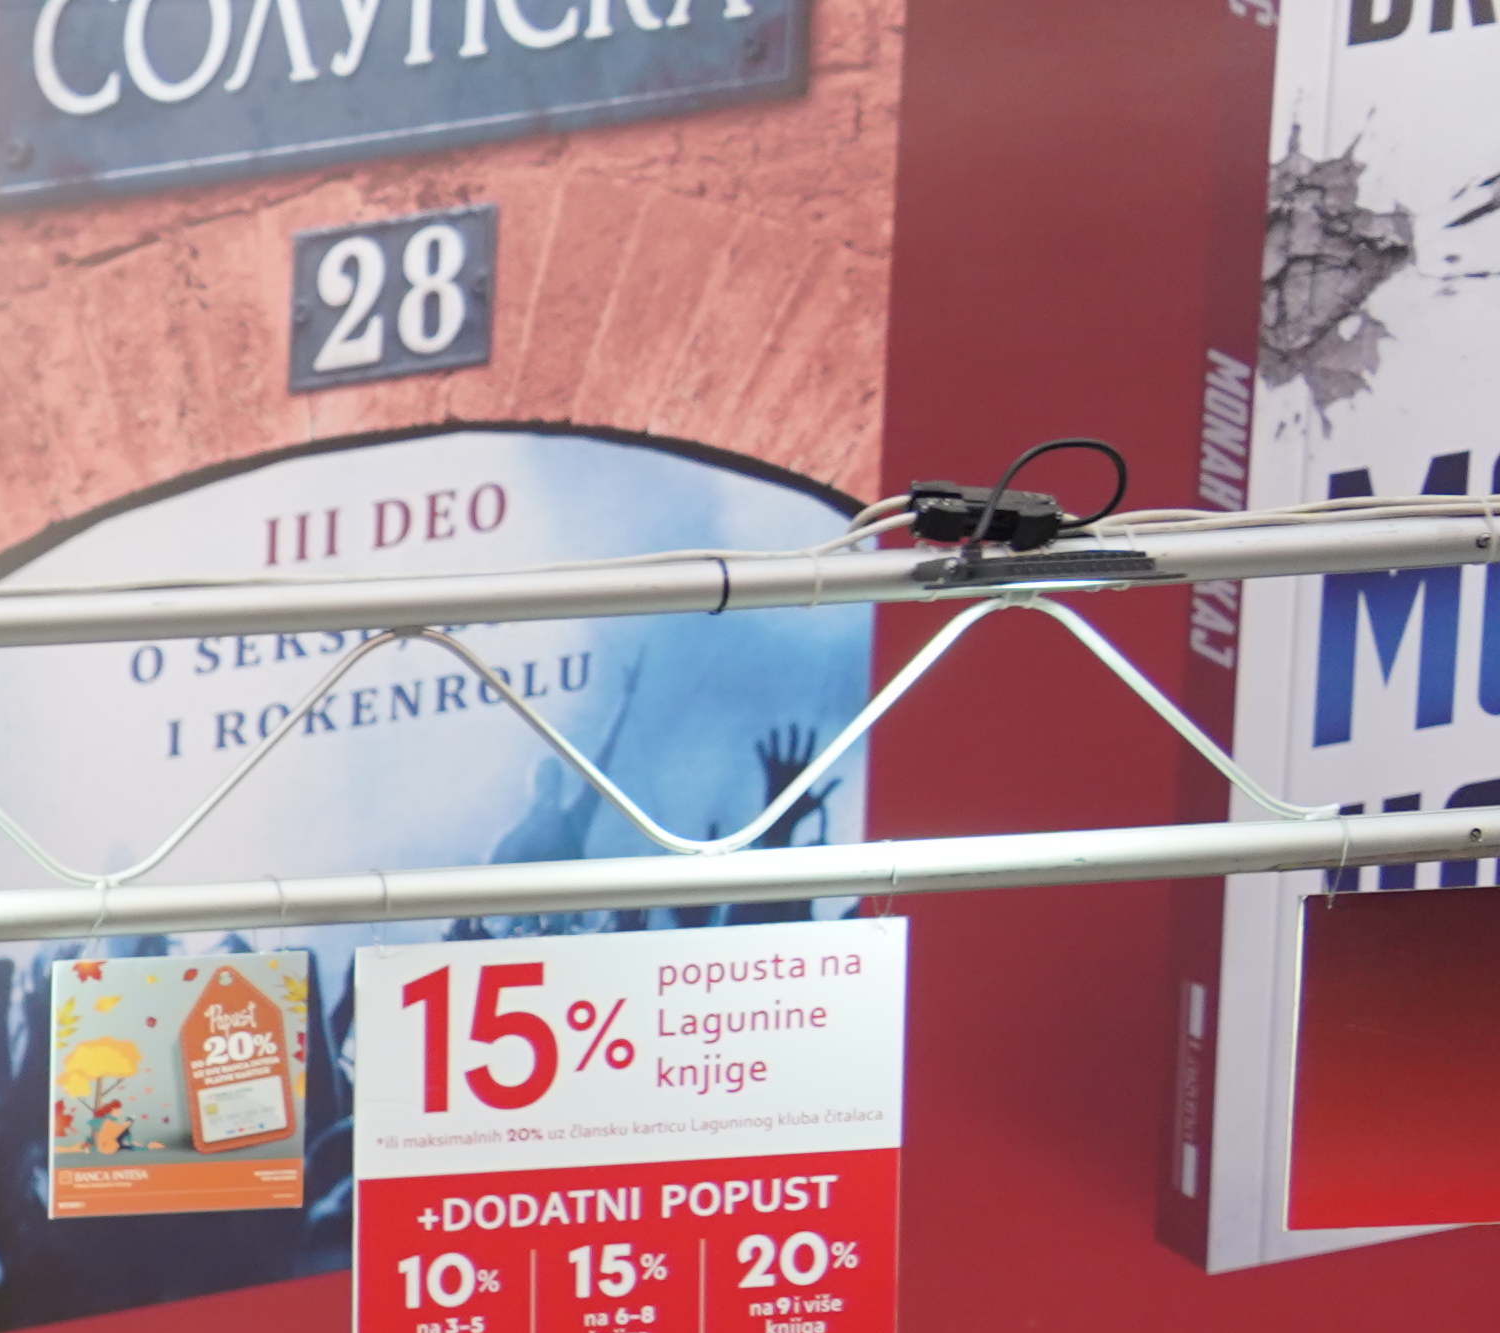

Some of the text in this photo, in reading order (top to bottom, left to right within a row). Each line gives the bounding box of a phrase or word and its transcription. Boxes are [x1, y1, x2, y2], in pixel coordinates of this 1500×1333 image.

[32, 0, 760, 116] СОЛУН
[314, 224, 467, 371] 28
[265, 483, 510, 567] III DEO
[1190, 349, 1251, 669] MONAH KAJ
[130, 625, 410, 684] O SEKS,
[167, 651, 593, 758] I ROKENROLU
[203, 1031, 278, 1066] 20%
[402, 953, 863, 1114] 15% popusta na
[657, 1000, 828, 1044] Lagunine
[656, 1055, 769, 1095] knjige
[402, 1128, 502, 1150] maksimalnih
[506, 1127, 543, 1143] 20%
[632, 1117, 686, 1137] karticu
[690, 1113, 774, 1135] Laguninog
[777, 1111, 820, 1127] kluba
[417, 1174, 839, 1233] +DODATNI POPUST
[397, 1252, 500, 1309] 10%
[567, 1242, 668, 1300] 15%
[736, 1230, 859, 1291] 20%
[584, 1311, 610, 1328] na
[748, 1300, 774, 1318] na
[775, 1297, 791, 1317] 9
[803, 1294, 844, 1314] više
